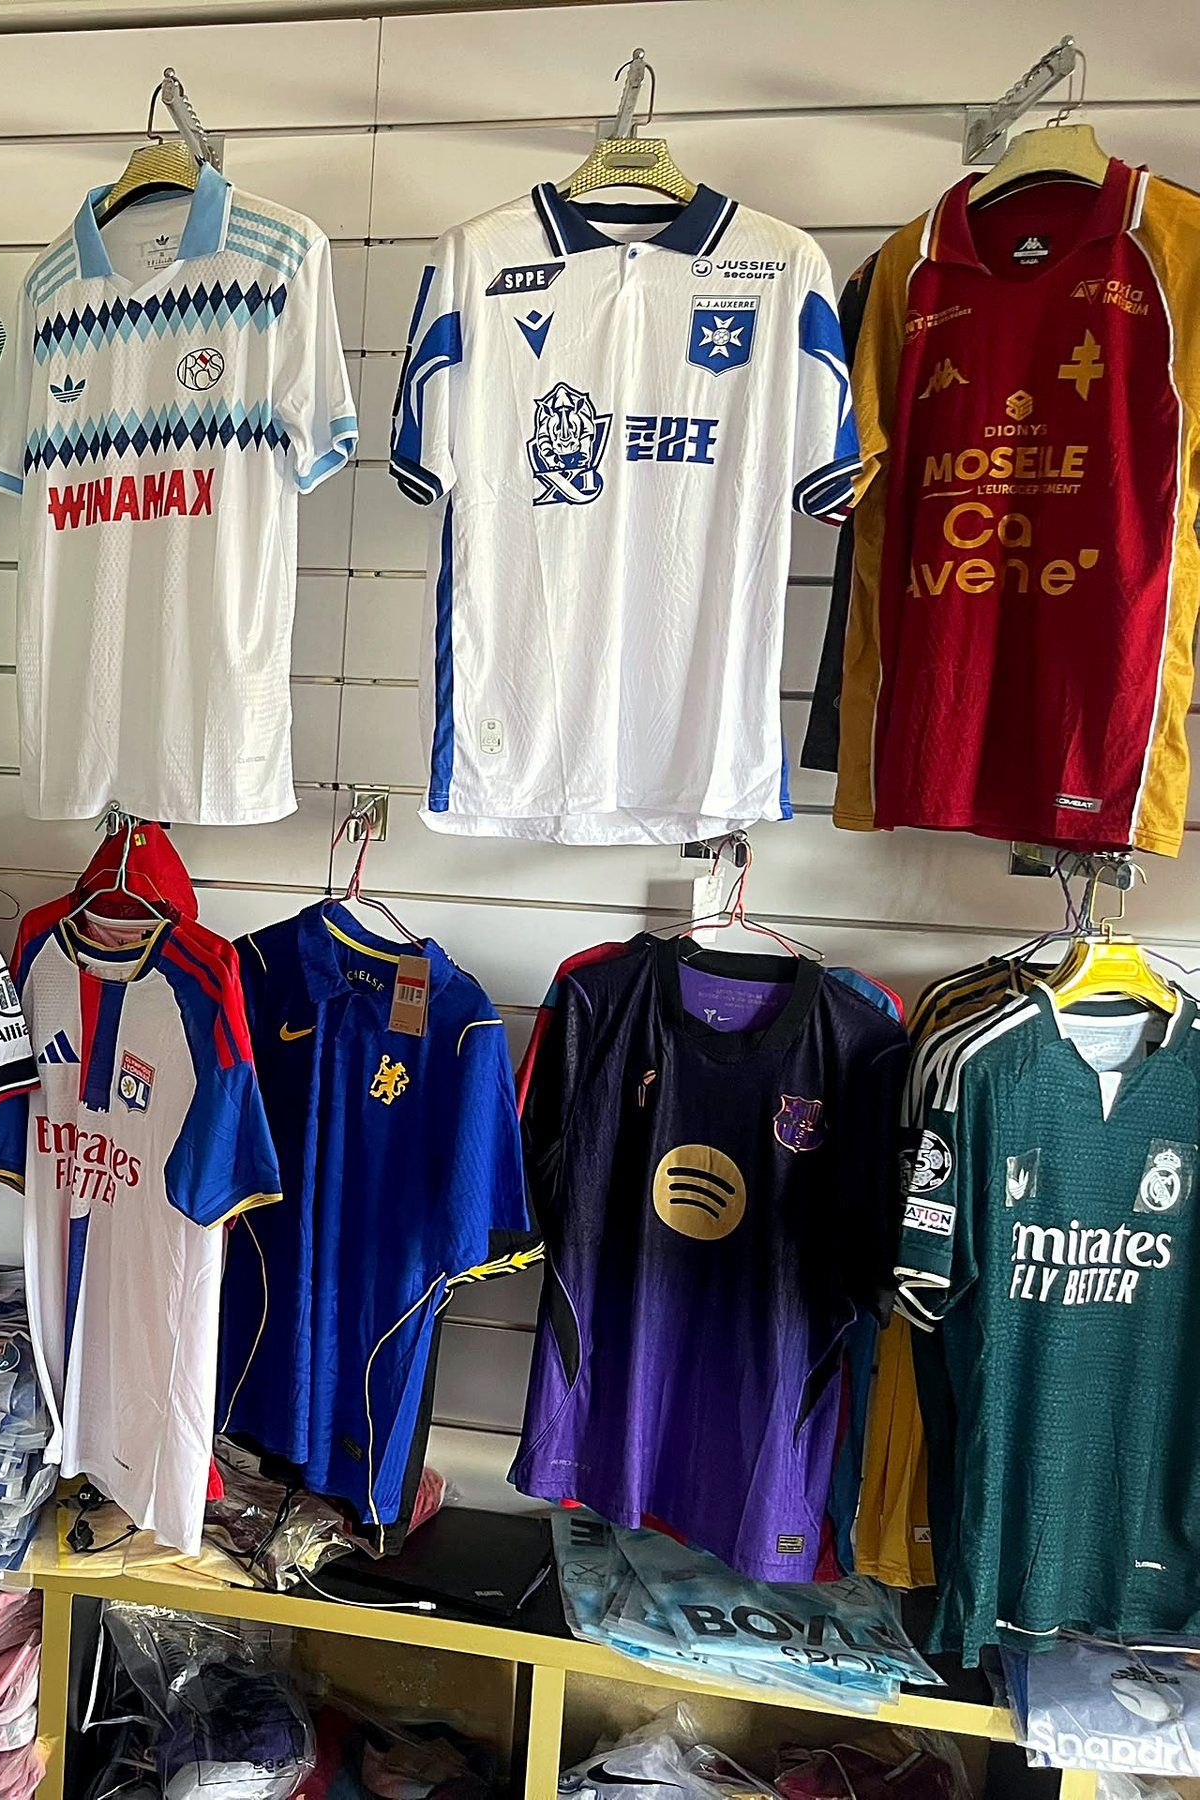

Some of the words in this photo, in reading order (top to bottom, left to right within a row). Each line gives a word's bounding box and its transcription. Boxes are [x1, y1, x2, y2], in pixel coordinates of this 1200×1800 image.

[716, 260, 786, 272] JUSSIEU
[723, 270, 775, 280] secours
[505, 269, 545, 289] SPPE
[48, 468, 215, 531] WINAMAX
[905, 1206, 951, 1225] ATION
[1009, 1264, 1059, 1302] FLY
[1062, 1268, 1140, 1306] BETTER
[1029, 1718, 1197, 1770] Snapdr
